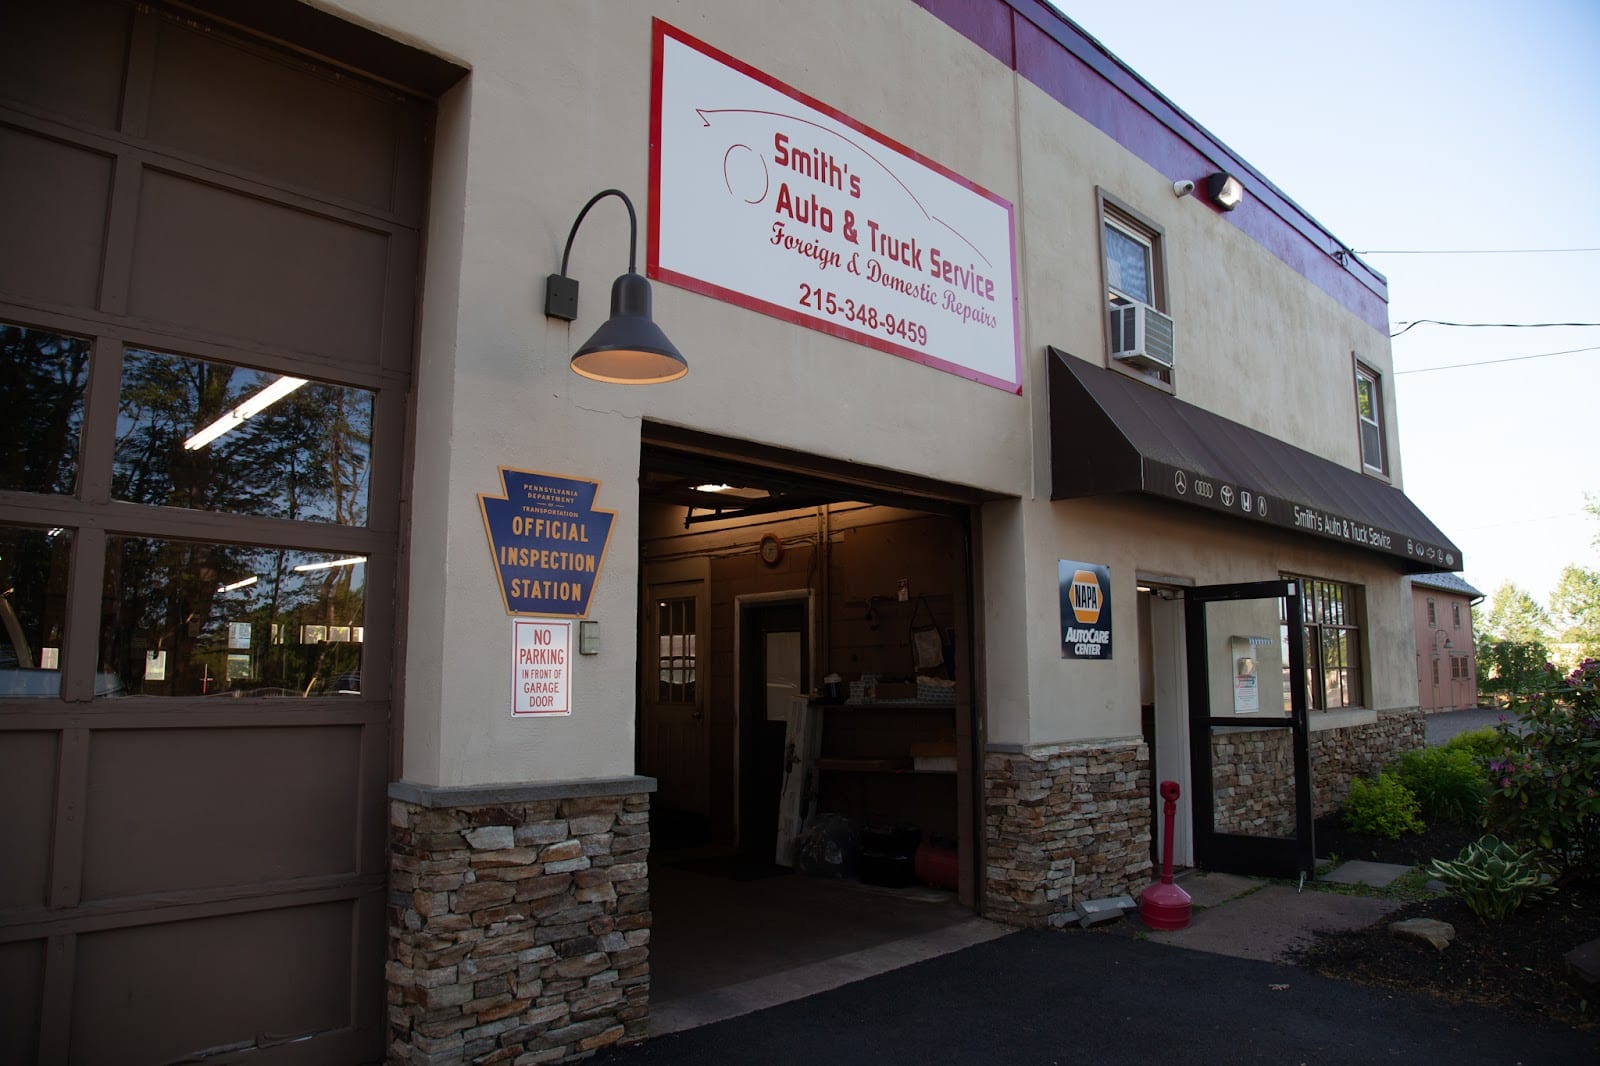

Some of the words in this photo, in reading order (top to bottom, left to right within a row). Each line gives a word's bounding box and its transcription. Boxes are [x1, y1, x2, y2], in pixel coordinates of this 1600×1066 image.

[774, 132, 861, 199] Smith's
[775, 182, 833, 233] Auto
[843, 209, 859, 245] &
[867, 219, 922, 271] Truck
[930, 247, 995, 301] Service
[770, 221, 841, 270] Foreign
[847, 252, 861, 276] &
[866, 258, 938, 305] Domestic
[942, 289, 997, 329] Repairs
[799, 283, 928, 346] 215-348-9459
[523, 484, 578, 497] PENNSYLVANIA
[527, 492, 575, 504] DEPARTMENT
[522, 505, 579, 518] TRANSPORTATION
[512, 515, 589, 543] OFFICIAL
[1294, 505, 1323, 532] Smith's
[1324, 514, 1342, 537] Auto
[1342, 520, 1350, 538] &
[1350, 522, 1369, 544] Truck
[1369, 527, 1392, 550] Service
[501, 546, 595, 573] INSPECTION
[511, 578, 581, 602] STATION
[1074, 584, 1098, 609] NAPA
[533, 629, 552, 646] NO
[519, 648, 564, 665] PARKING
[1074, 643, 1101, 656] CENTER
[522, 669, 529, 679] IN
[531, 669, 552, 679] FRONT
[554, 669, 562, 679] OF
[523, 682, 560, 694] GARAGE
[529, 696, 554, 707] DOOR
